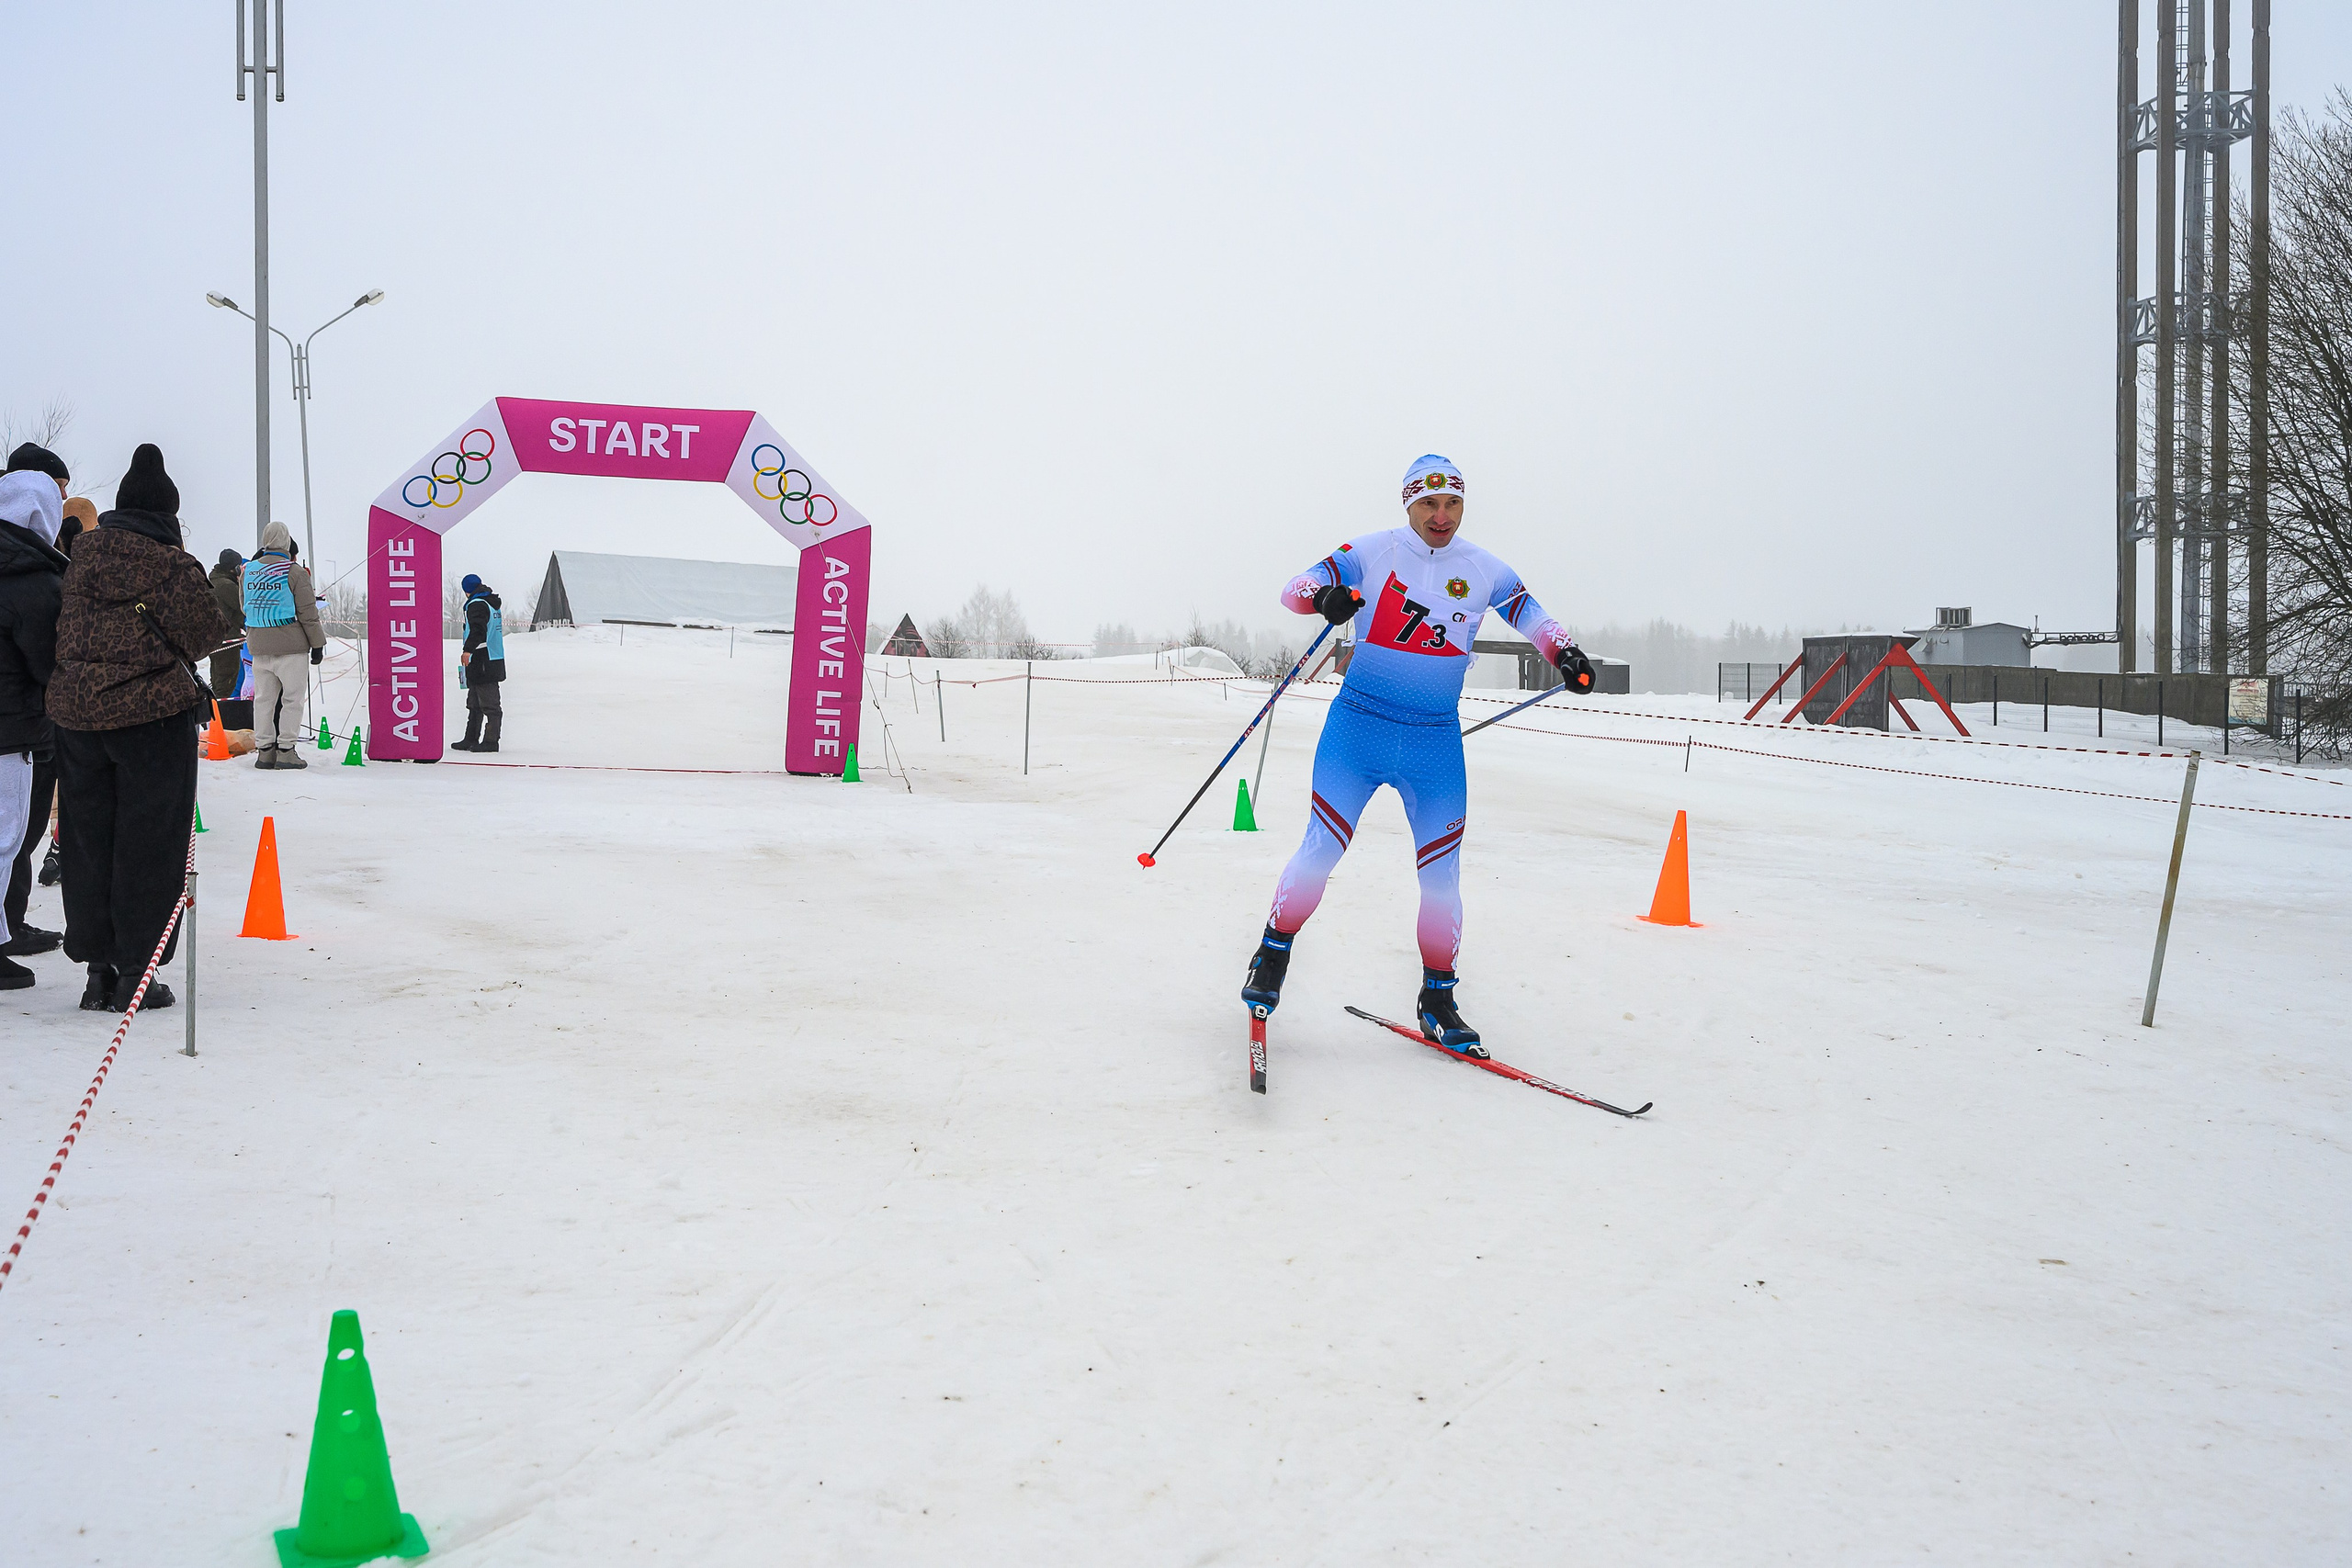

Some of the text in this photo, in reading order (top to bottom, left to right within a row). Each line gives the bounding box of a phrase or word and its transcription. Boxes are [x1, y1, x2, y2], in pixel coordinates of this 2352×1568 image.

[548, 417, 700, 459] START
[247, 581, 281, 591] СУДЬЯ
[388, 538, 419, 742] ACTIVE LIFE
[1394, 598, 1447, 649] 7.3
[814, 557, 850, 757] ACTIVE LIFE
